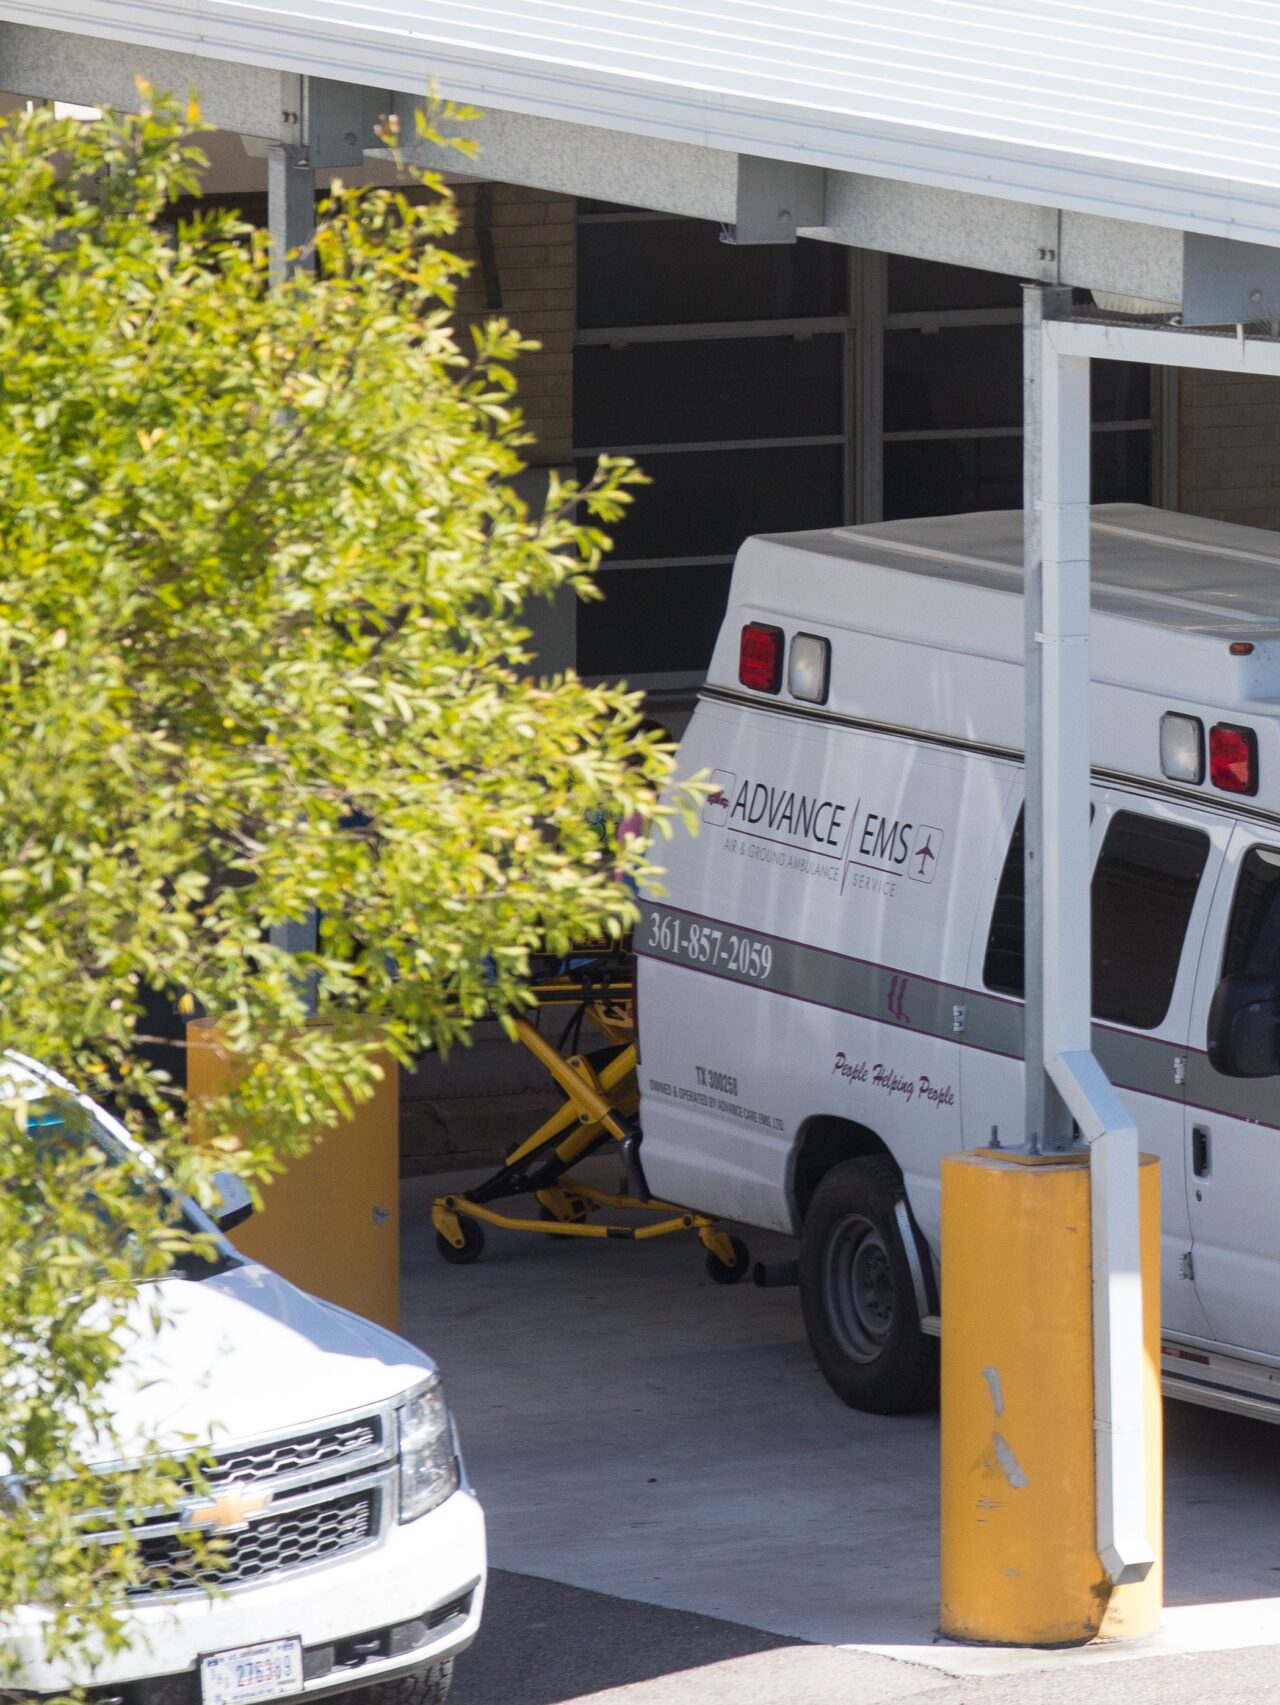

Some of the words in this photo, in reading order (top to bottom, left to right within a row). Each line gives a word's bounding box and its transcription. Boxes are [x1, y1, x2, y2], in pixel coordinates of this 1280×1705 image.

[730, 780, 845, 846] ADVANCE
[859, 813, 912, 864] EMS
[723, 838, 737, 853] AIR
[739, 842, 746, 855] &
[748, 844, 785, 866] GROUND
[785, 854, 840, 882] AMBULANCE
[852, 872, 897, 897] SERVICE
[648, 912, 772, 979] 361-857-2059
[649, 1079, 672, 1096] OWNED
[678, 1087, 708, 1106] OPERATED
[708, 1096, 717, 1108] BY
[718, 1099, 743, 1118] ADVANCE
[743, 1107, 758, 1123] CARE
[695, 1065, 707, 1086] TX
[832, 1051, 869, 1085] People
[872, 1063, 915, 1103] Helping
[918, 1075, 955, 1109] People
